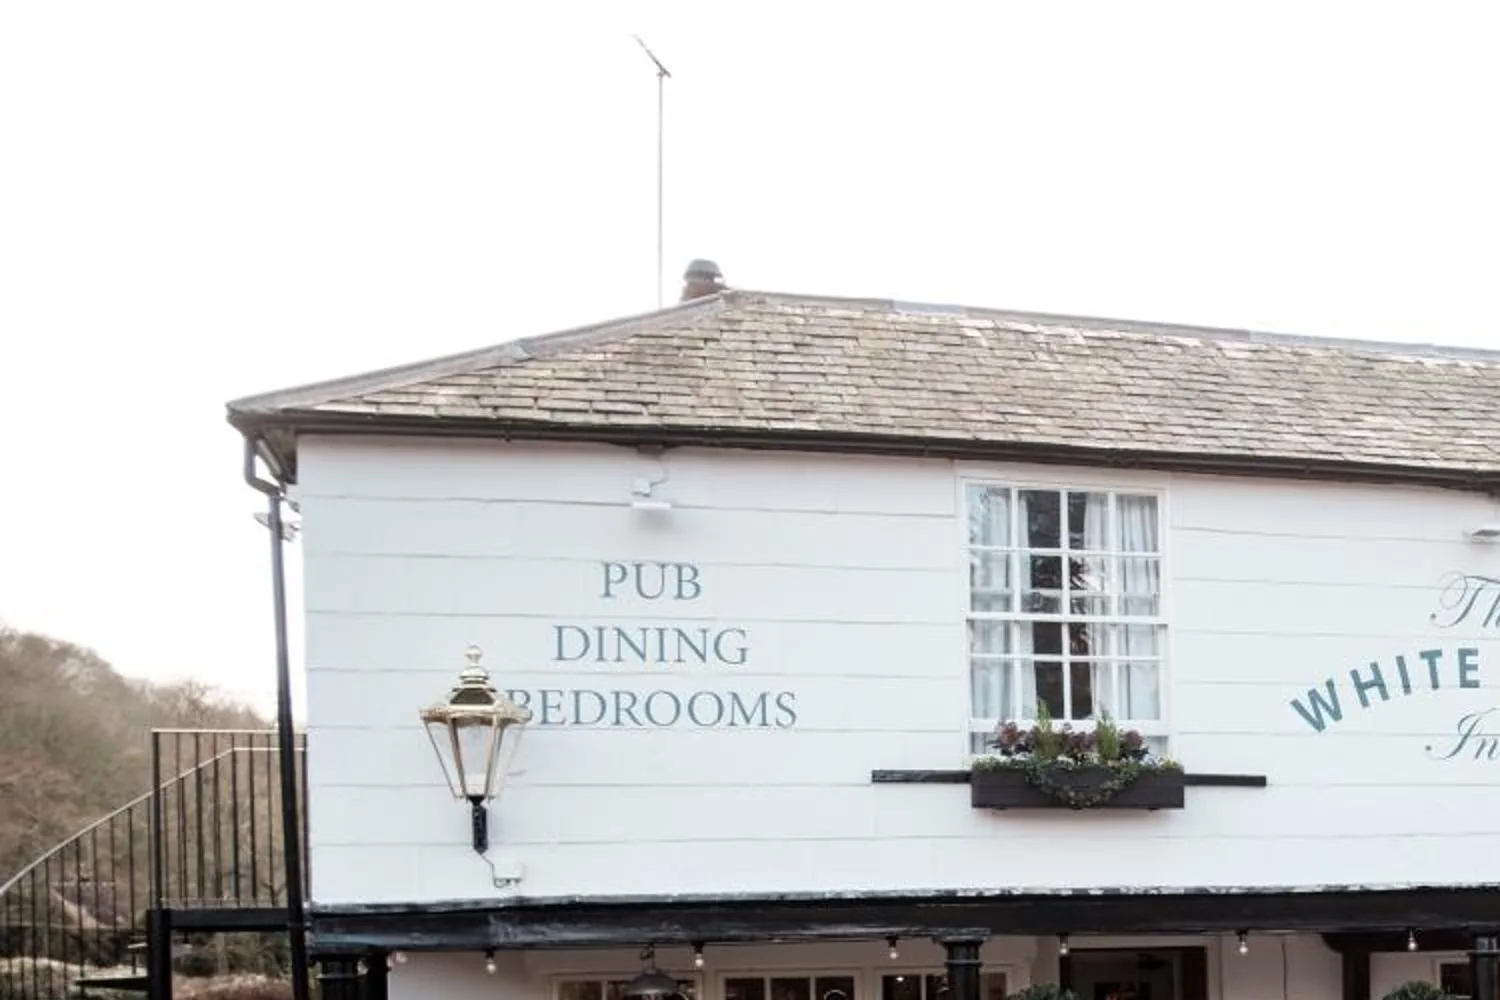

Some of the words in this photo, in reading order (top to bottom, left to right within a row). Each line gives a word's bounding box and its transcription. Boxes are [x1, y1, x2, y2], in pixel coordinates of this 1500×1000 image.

[599, 561, 703, 601] PUB
[552, 624, 749, 666] DINING
[505, 687, 798, 730] BEDROOMS
[1290, 647, 1481, 734] WHITE
